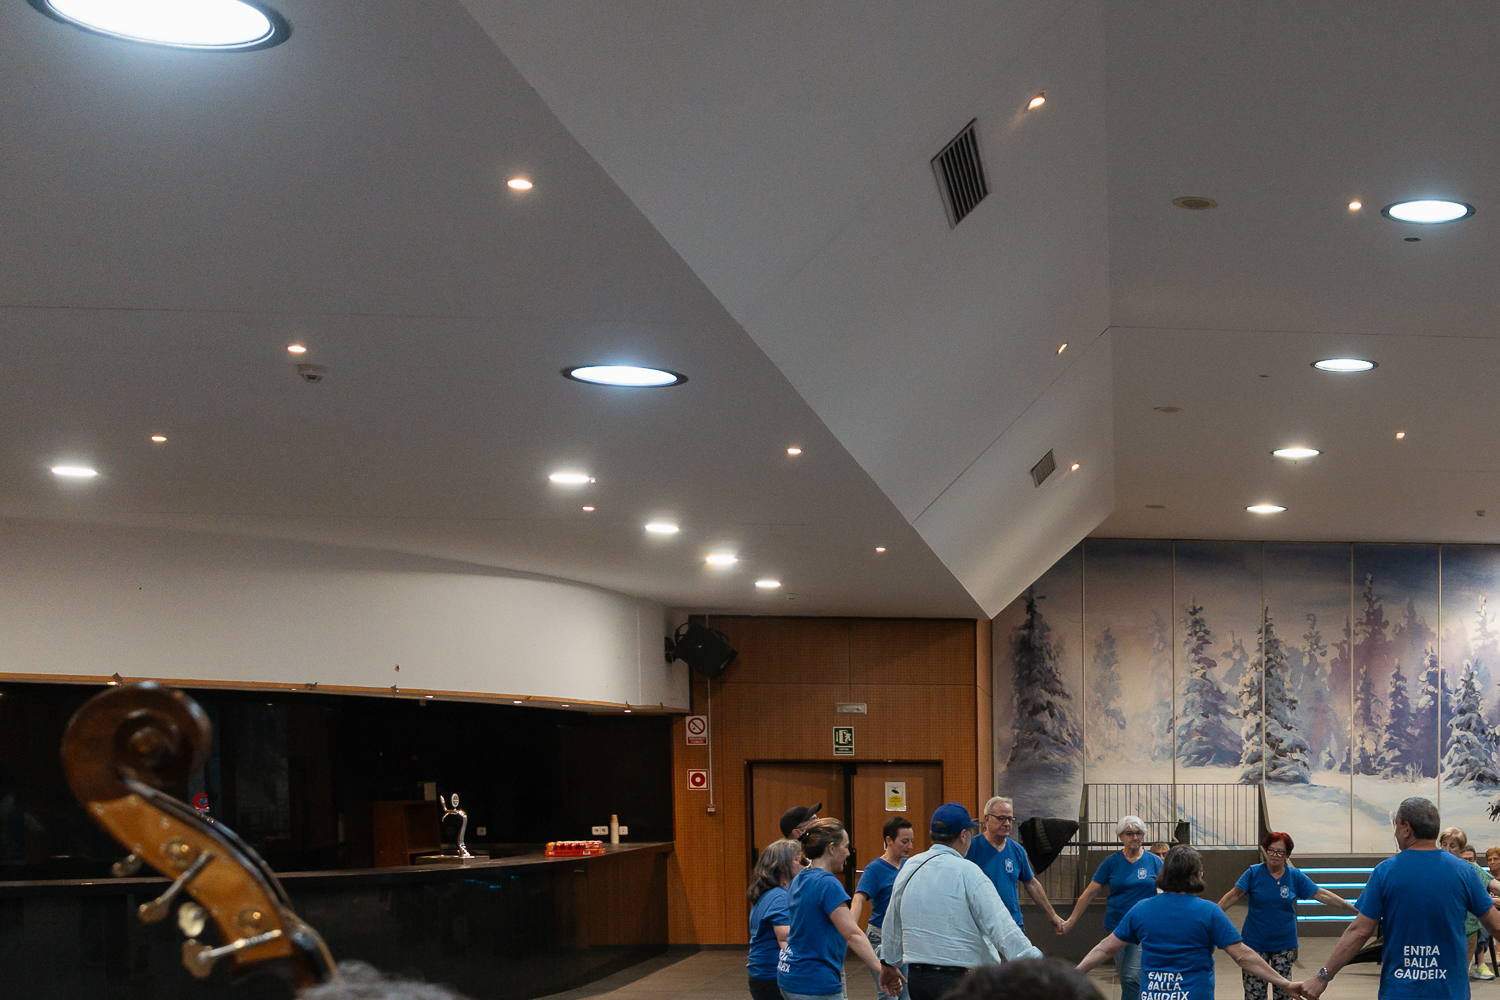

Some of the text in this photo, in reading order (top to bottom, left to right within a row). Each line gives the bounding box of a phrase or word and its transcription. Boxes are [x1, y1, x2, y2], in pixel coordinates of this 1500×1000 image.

[1404, 945, 1440, 956] ENTRA
[1404, 957, 1438, 968] BALLA
[1148, 972, 1183, 982] ENTRA
[1394, 968, 1447, 980] GAUDEIX
[1148, 981, 1182, 991] BALLA
